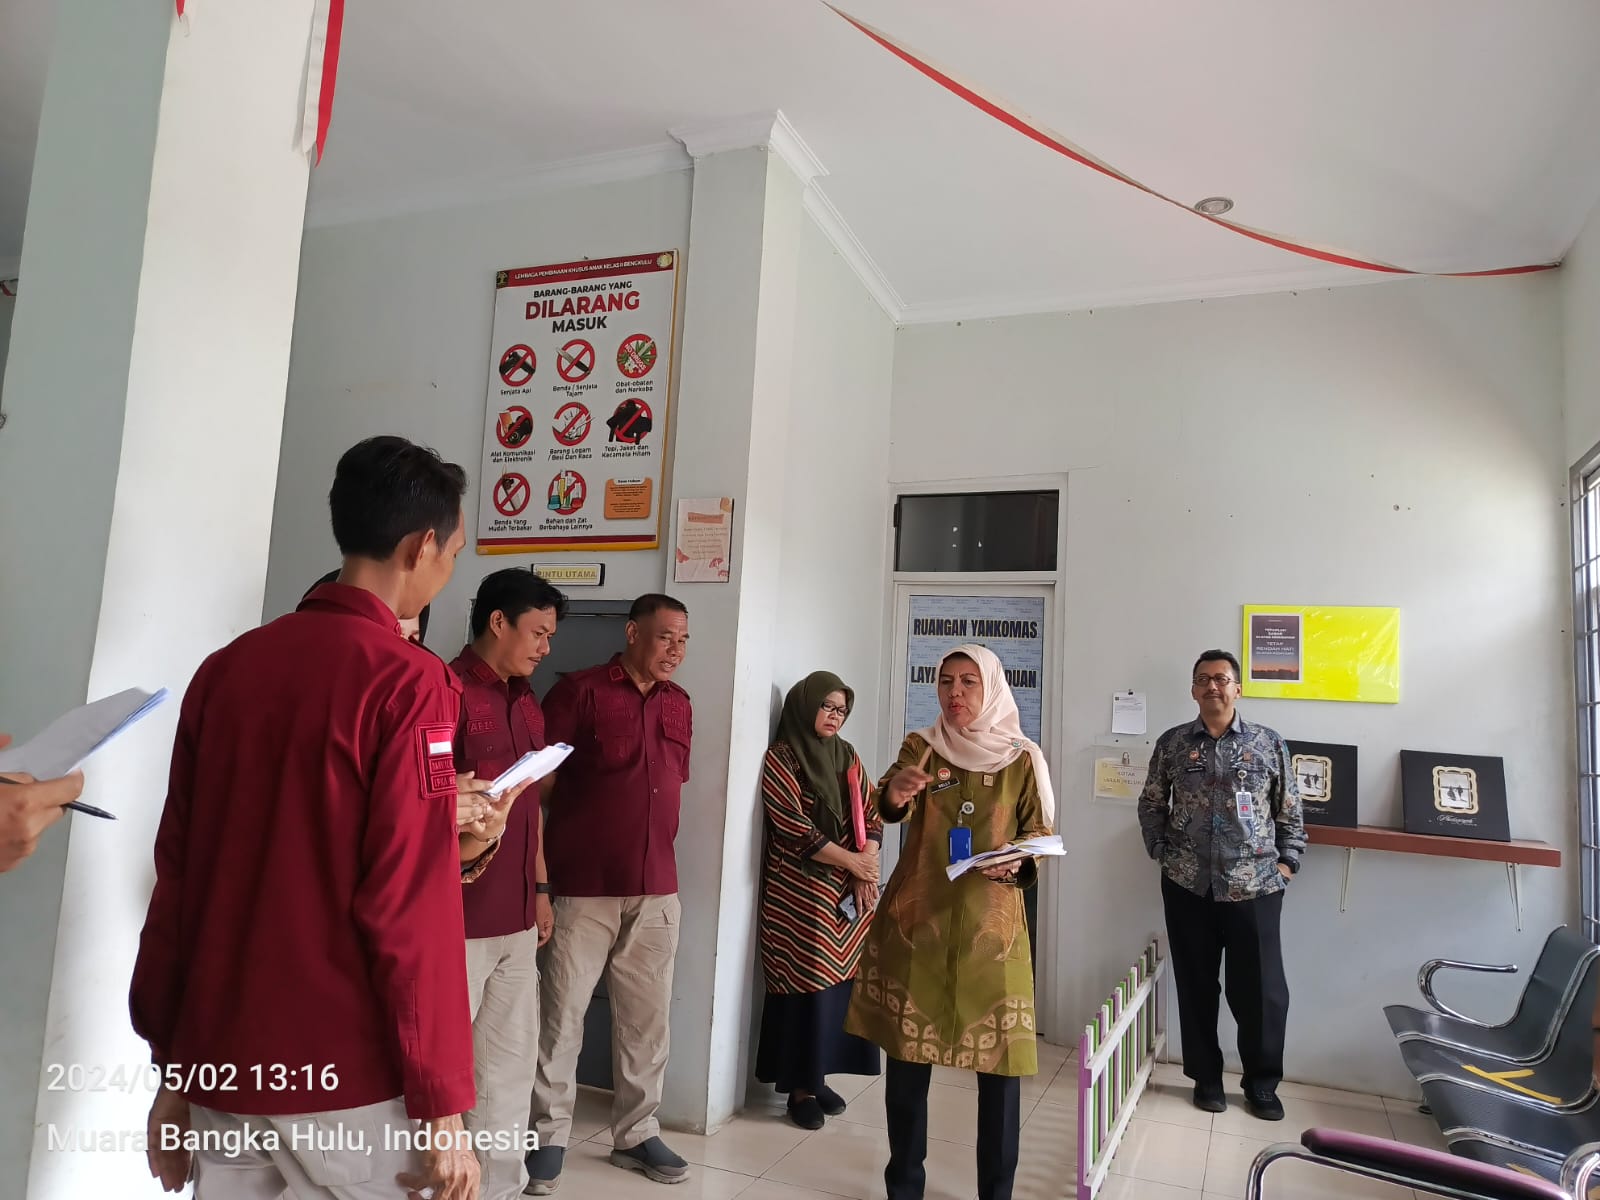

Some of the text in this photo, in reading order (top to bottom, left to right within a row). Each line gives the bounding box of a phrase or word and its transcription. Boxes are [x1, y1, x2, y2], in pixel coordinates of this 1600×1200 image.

[514, 272, 538, 280] LEMBAGA
[539, 269, 568, 277] PEMBINAAN
[624, 259, 653, 267] BENGKULU
[533, 280, 633, 298] BARANG-BARANG YANG
[525, 291, 641, 320] DILARANG
[552, 316, 608, 333] MASUK
[576, 383, 598, 391] Senjata
[549, 447, 592, 456] Barang Logam
[537, 570, 597, 578] PINTU UTAMA
[913, 618, 1038, 639] RUANGAN YANKOMAS
[911, 665, 1037, 688] LAYA DUAN
